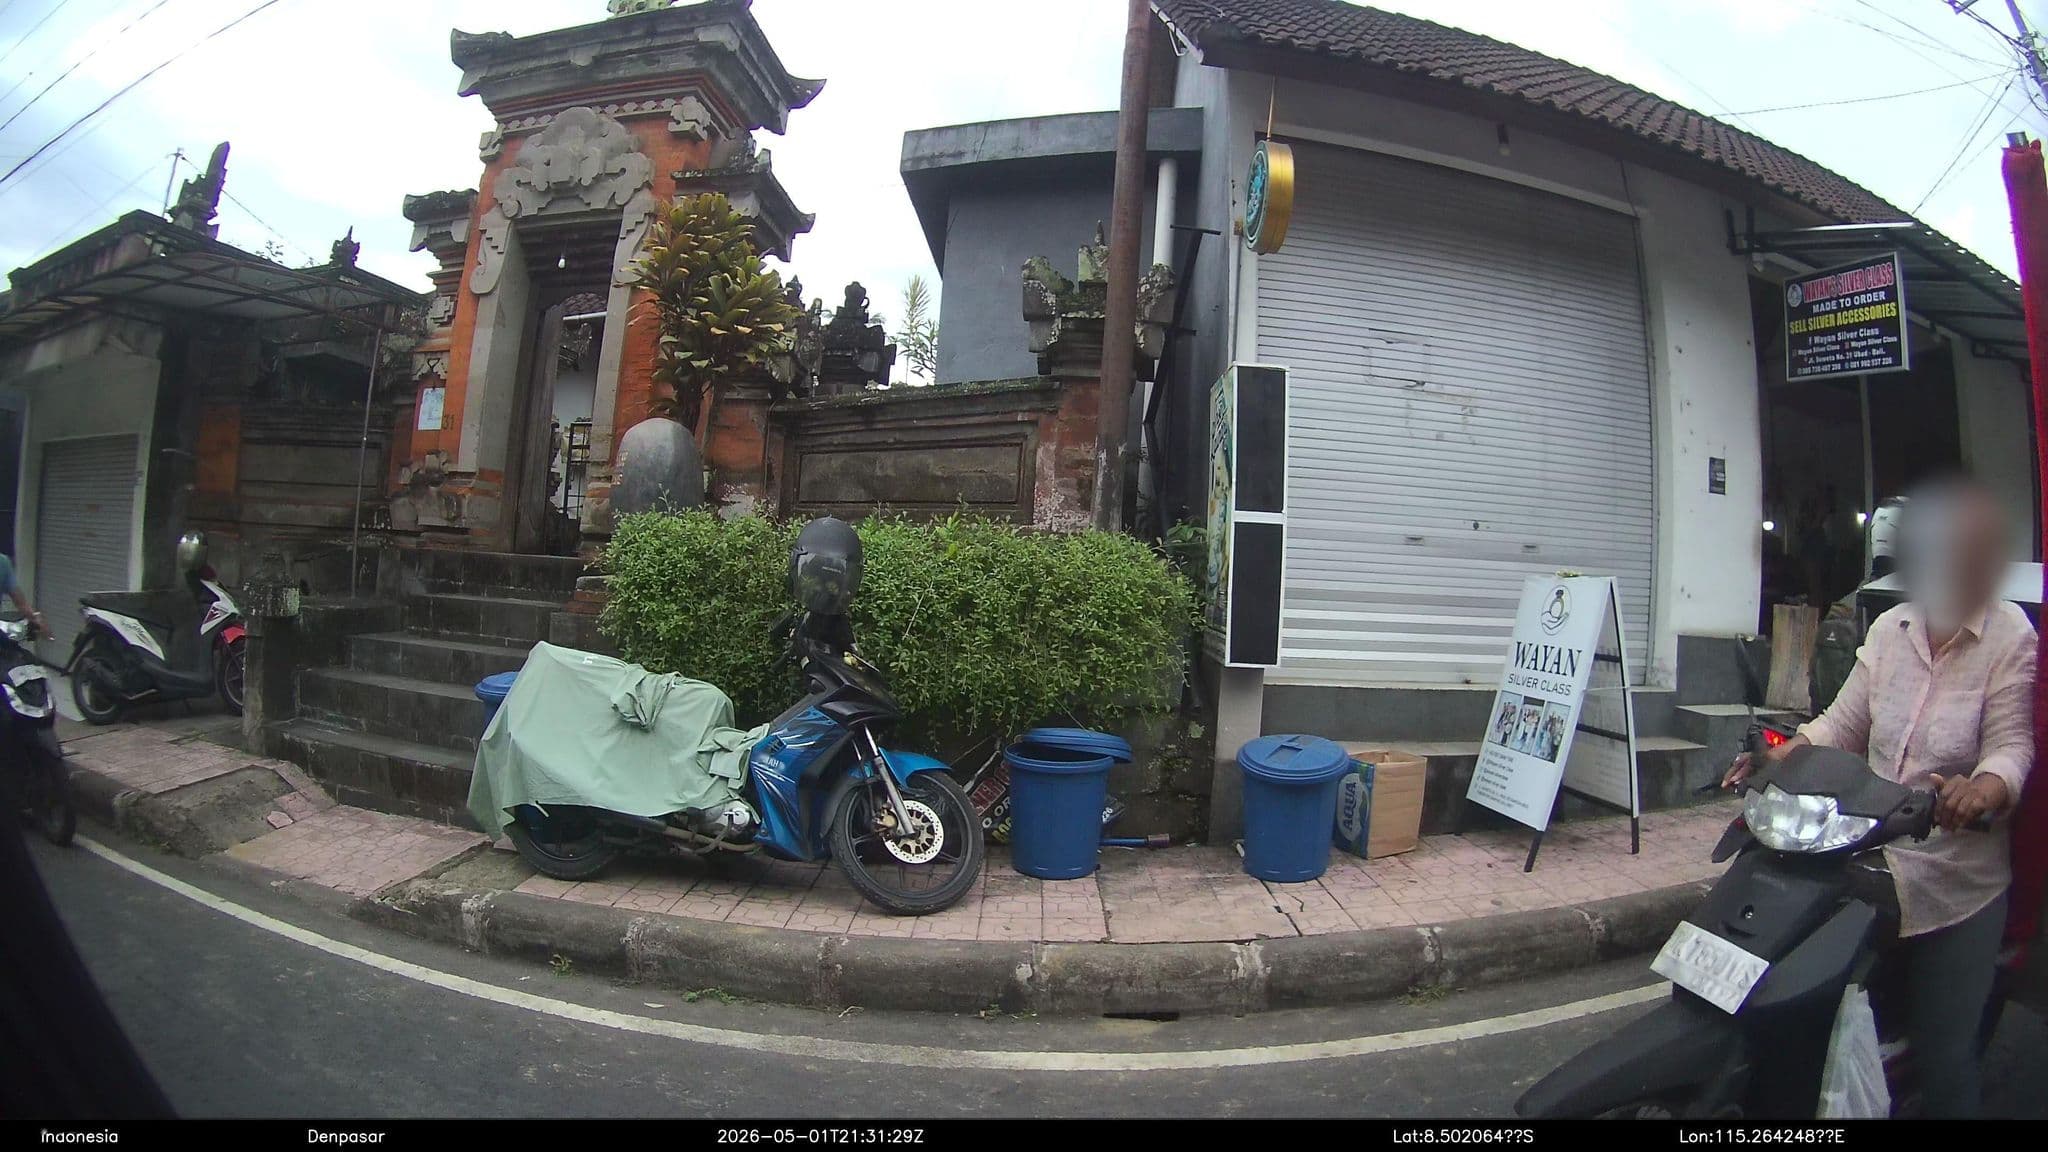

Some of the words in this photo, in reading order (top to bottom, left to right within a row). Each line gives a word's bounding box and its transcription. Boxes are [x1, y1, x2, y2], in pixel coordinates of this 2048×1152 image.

[1838, 269, 1866, 296] SILVER
[1865, 262, 1894, 290] CLASS
[1790, 319, 1808, 335] SELL
[1808, 313, 1836, 331] SILVER
[1837, 302, 1897, 326] ACCESSORIES
[1813, 300, 1837, 314] MADE
[1839, 298, 1851, 308] TO
[1854, 291, 1886, 305] ORDER
[1514, 641, 1582, 678] WAYAN
[1508, 673, 1538, 689] SILVER
[1540, 680, 1572, 696] CLASS
[1342, 782, 1356, 832] AQUA
